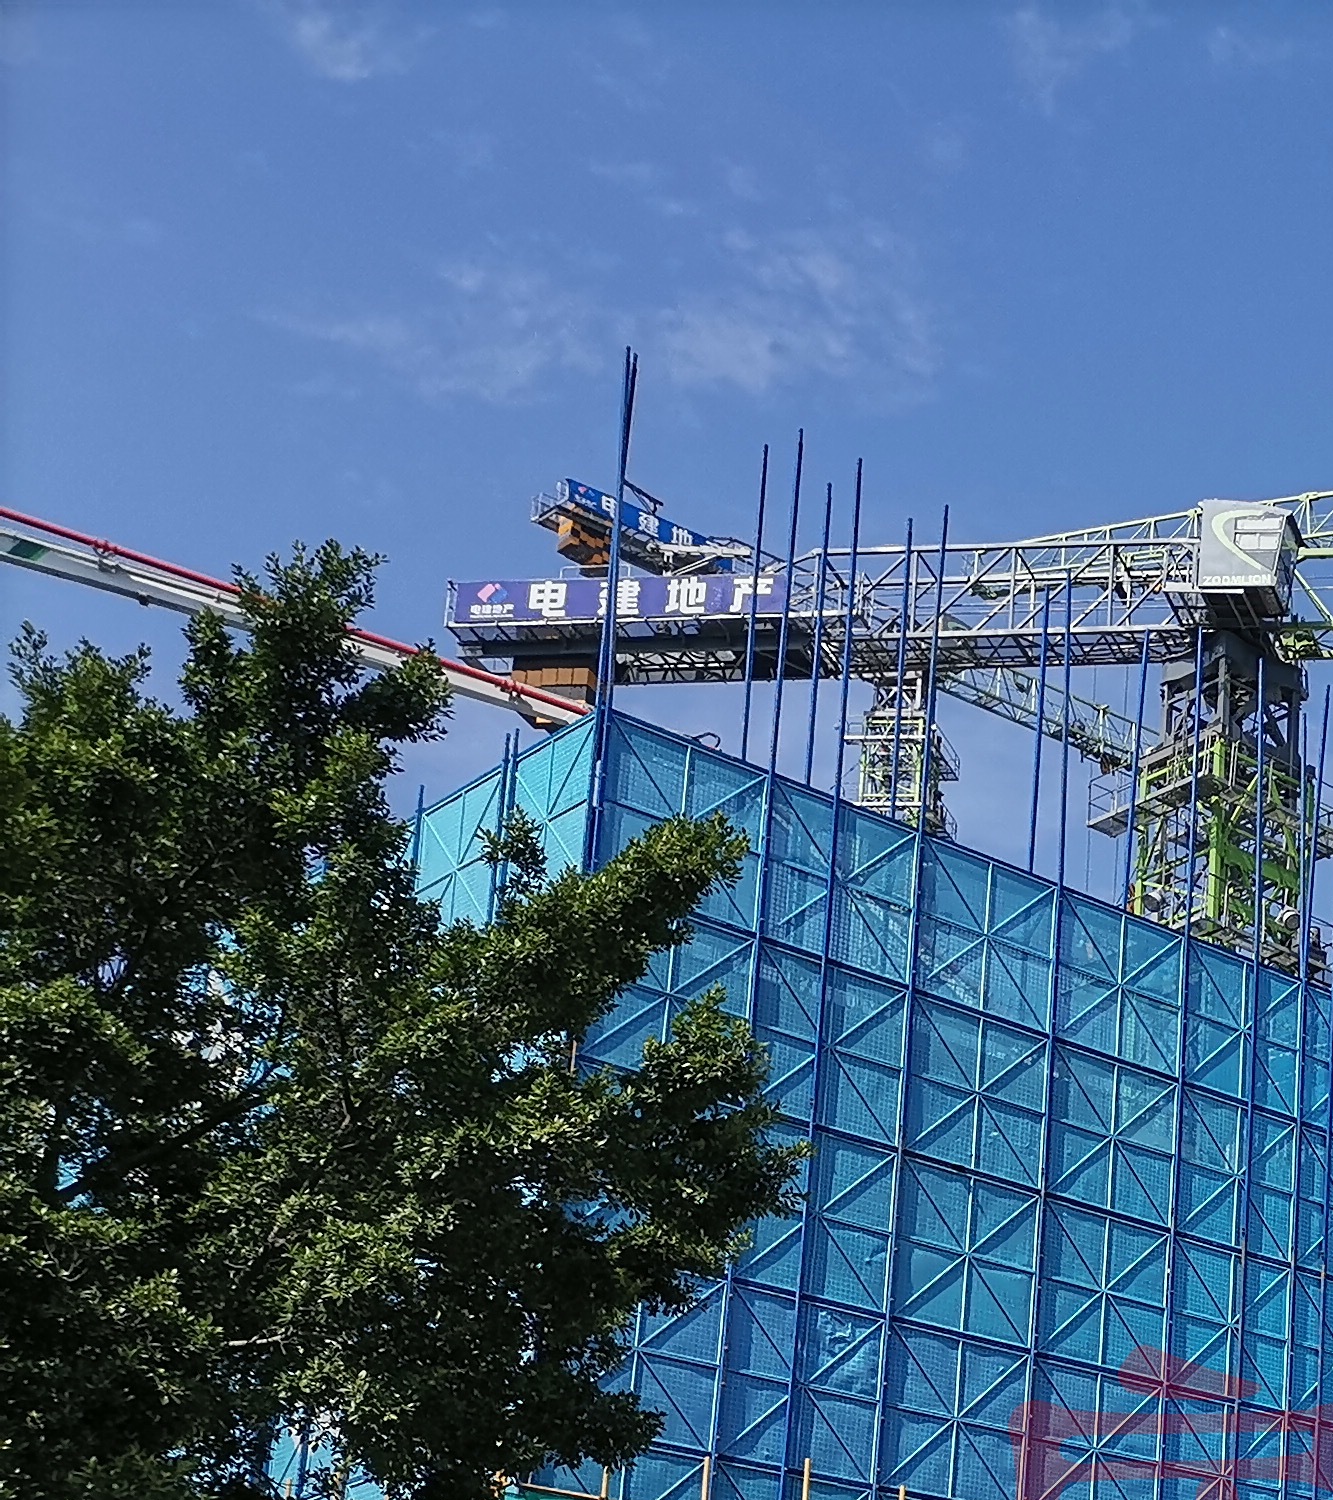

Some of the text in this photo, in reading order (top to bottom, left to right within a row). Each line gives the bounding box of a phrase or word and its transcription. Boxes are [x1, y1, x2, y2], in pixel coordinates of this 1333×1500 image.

[1202, 573, 1272, 586] ZOOMLION
[528, 578, 774, 617] 电建地产
